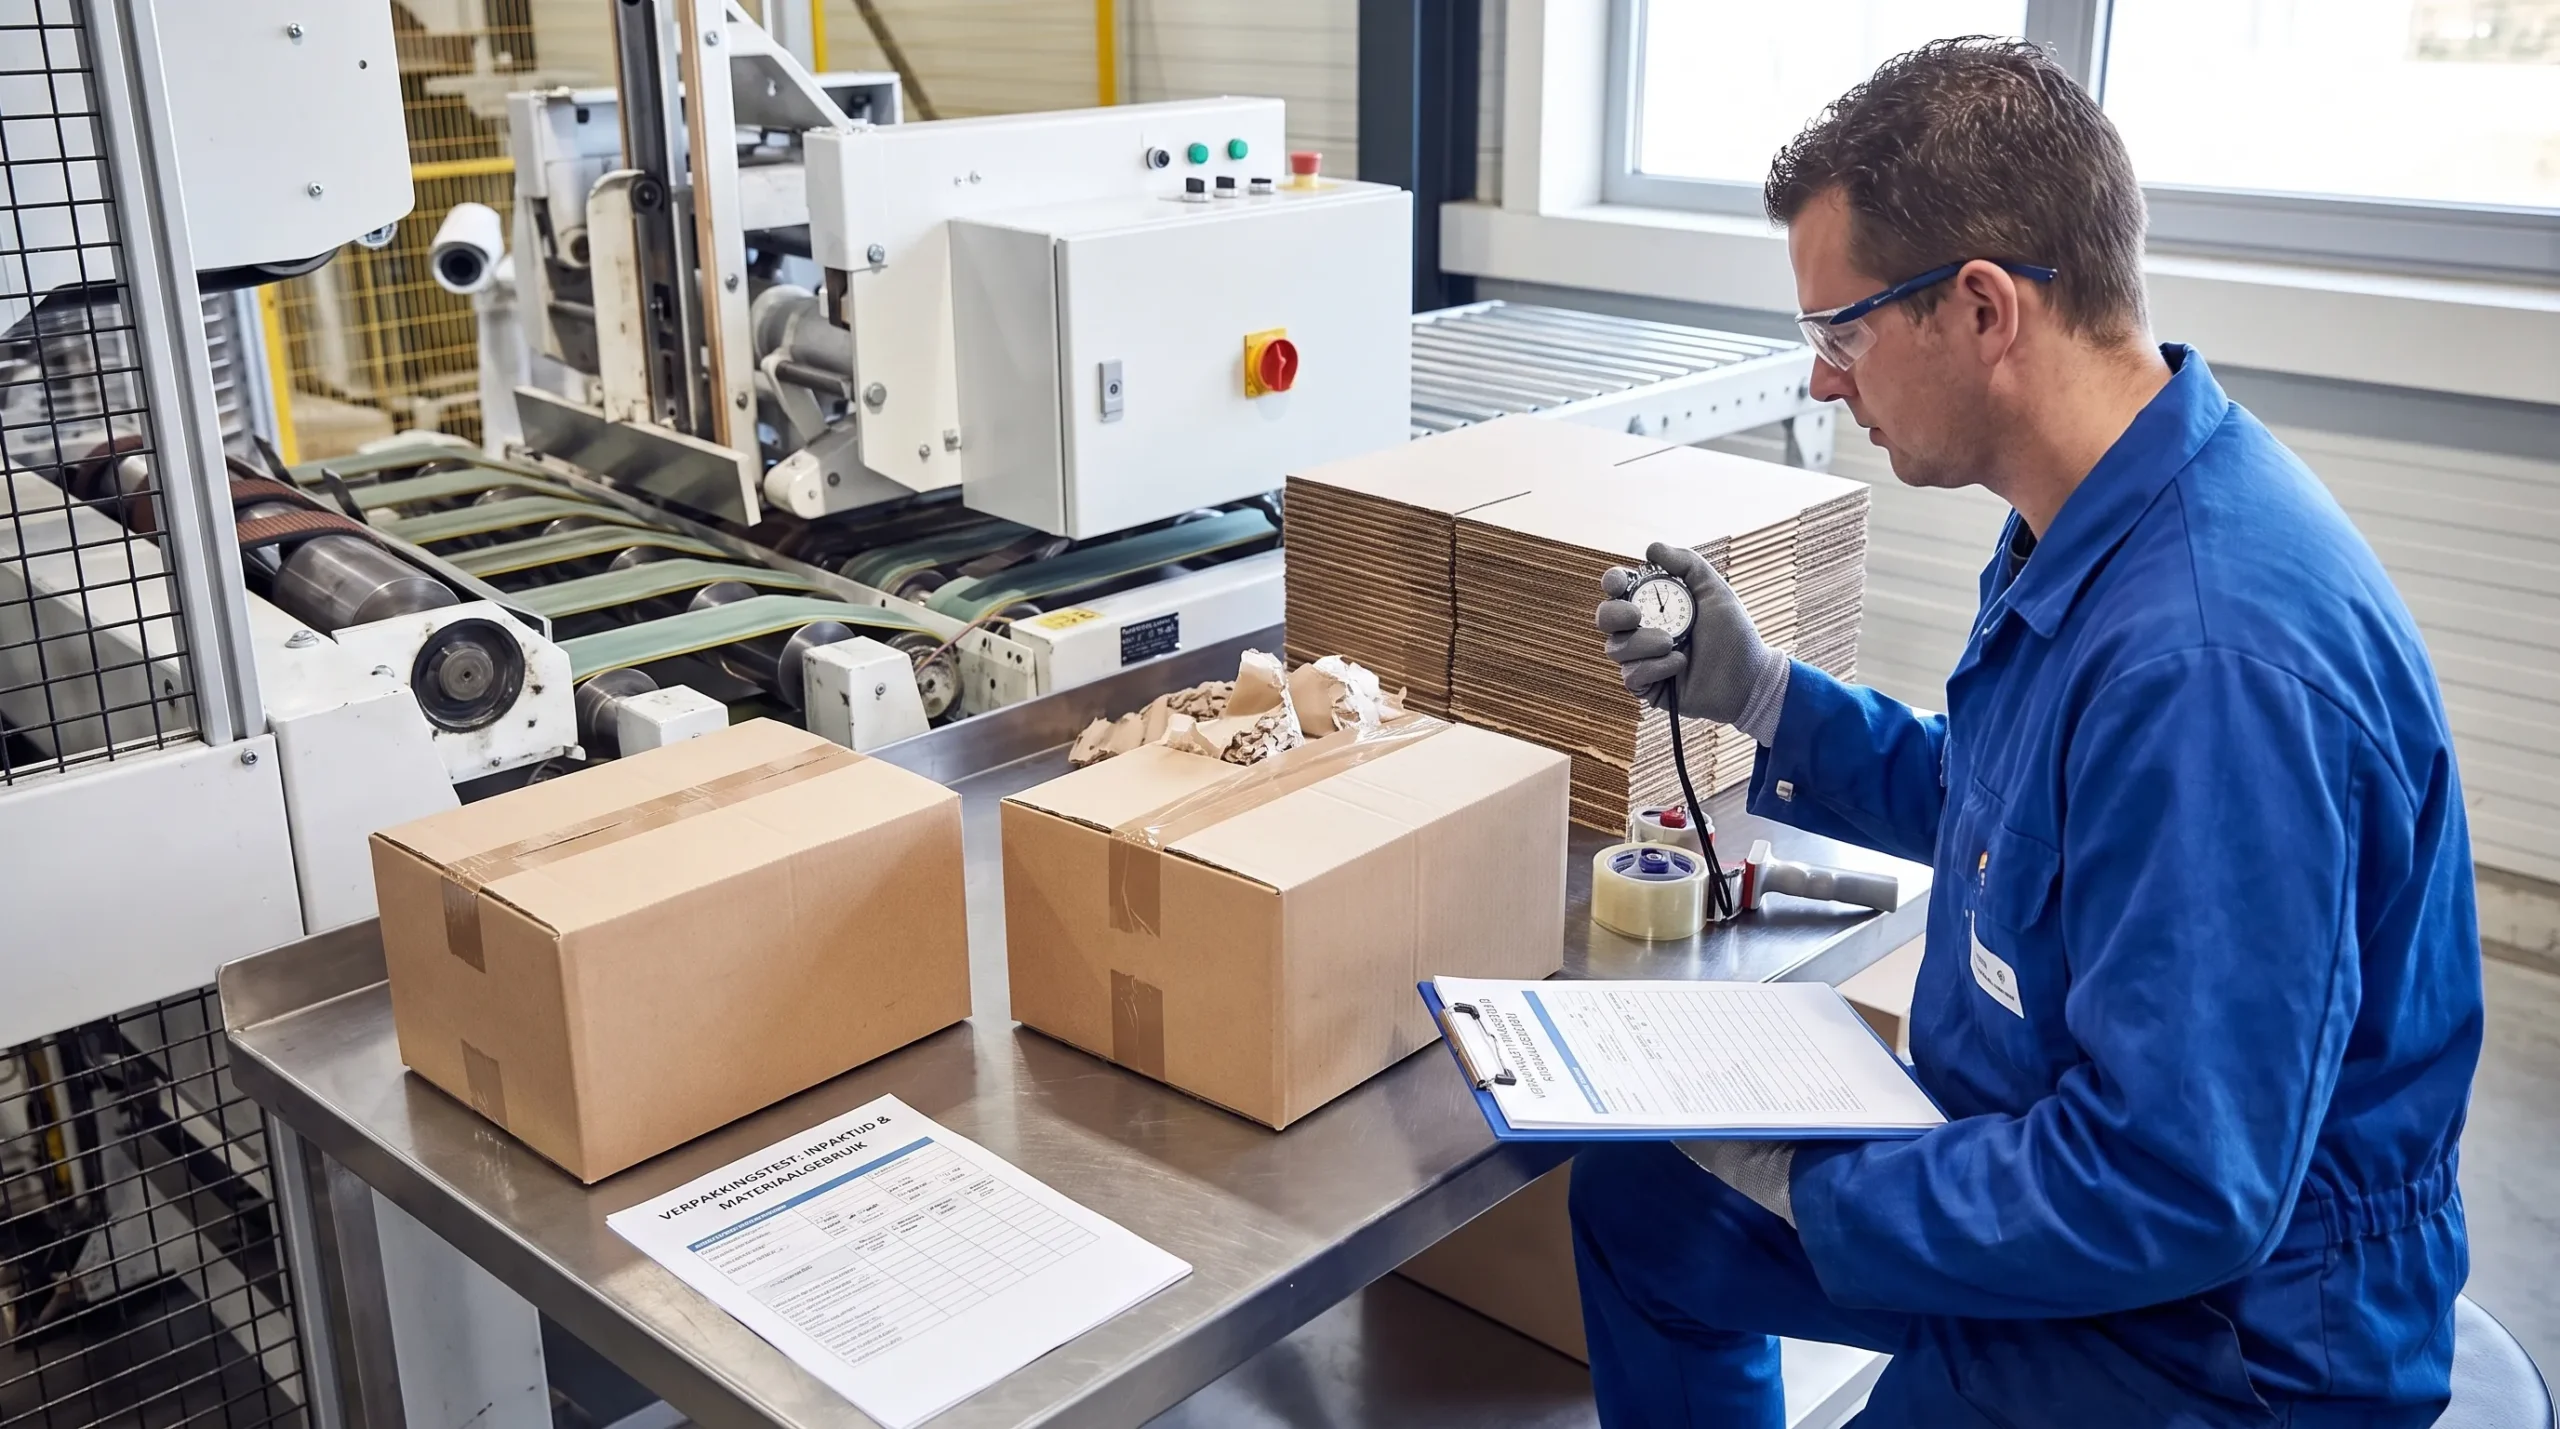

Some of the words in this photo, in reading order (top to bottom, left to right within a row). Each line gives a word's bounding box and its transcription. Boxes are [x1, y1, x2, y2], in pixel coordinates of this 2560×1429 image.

[658, 1153, 804, 1220] VERPAKKINGSTEST:
[876, 1115, 892, 1125] &
[718, 1141, 868, 1210] MATERIAALGEBRUIK
